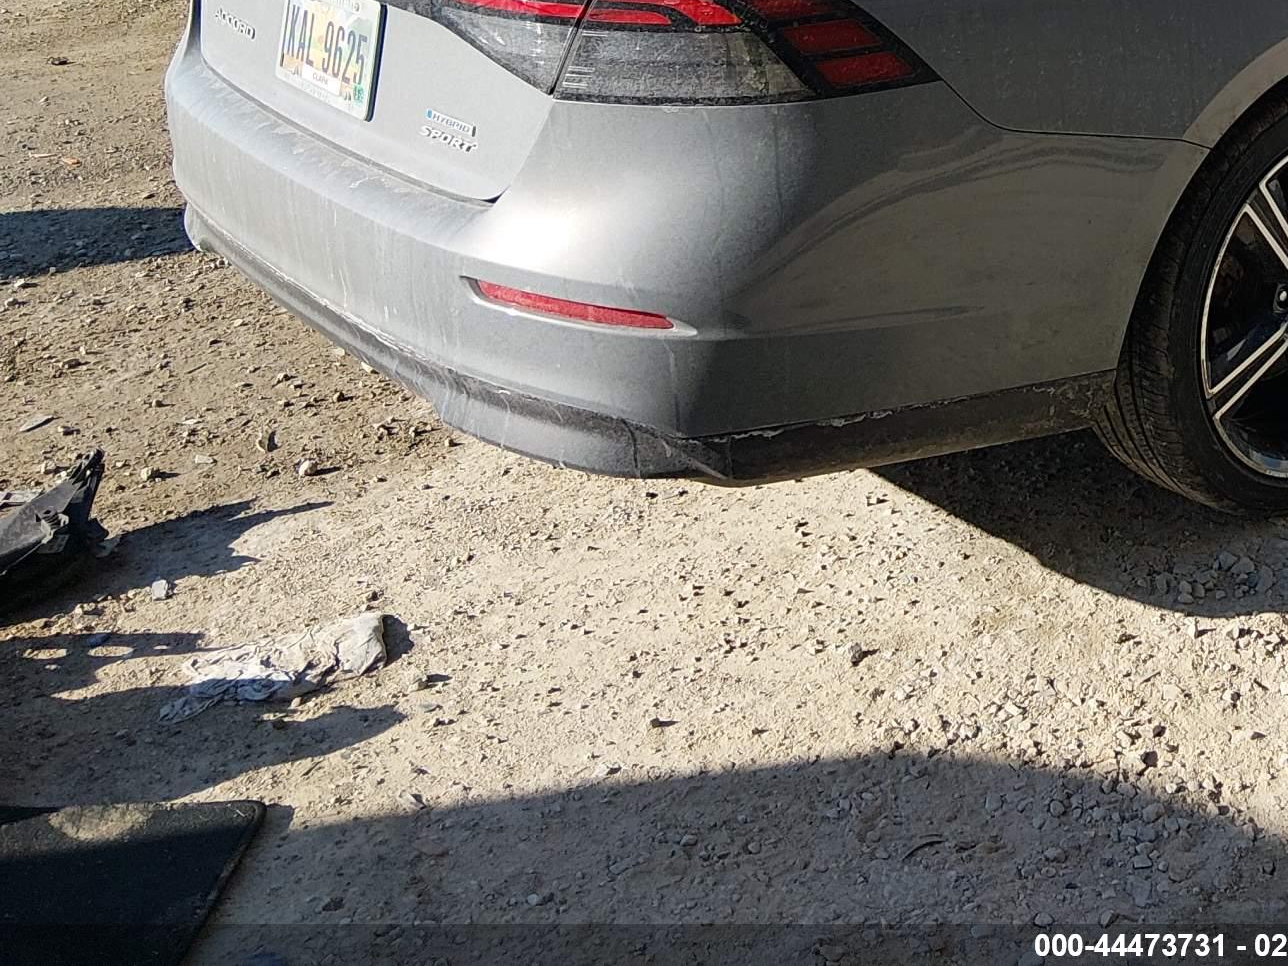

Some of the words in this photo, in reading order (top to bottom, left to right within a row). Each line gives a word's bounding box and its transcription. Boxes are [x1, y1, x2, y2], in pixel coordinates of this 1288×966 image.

[213, 7, 256, 41] ACCORD
[286, 3, 315, 67] KAL
[321, 20, 368, 86] 9625
[432, 111, 471, 134] HYBRID
[420, 125, 479, 154] SPORT
